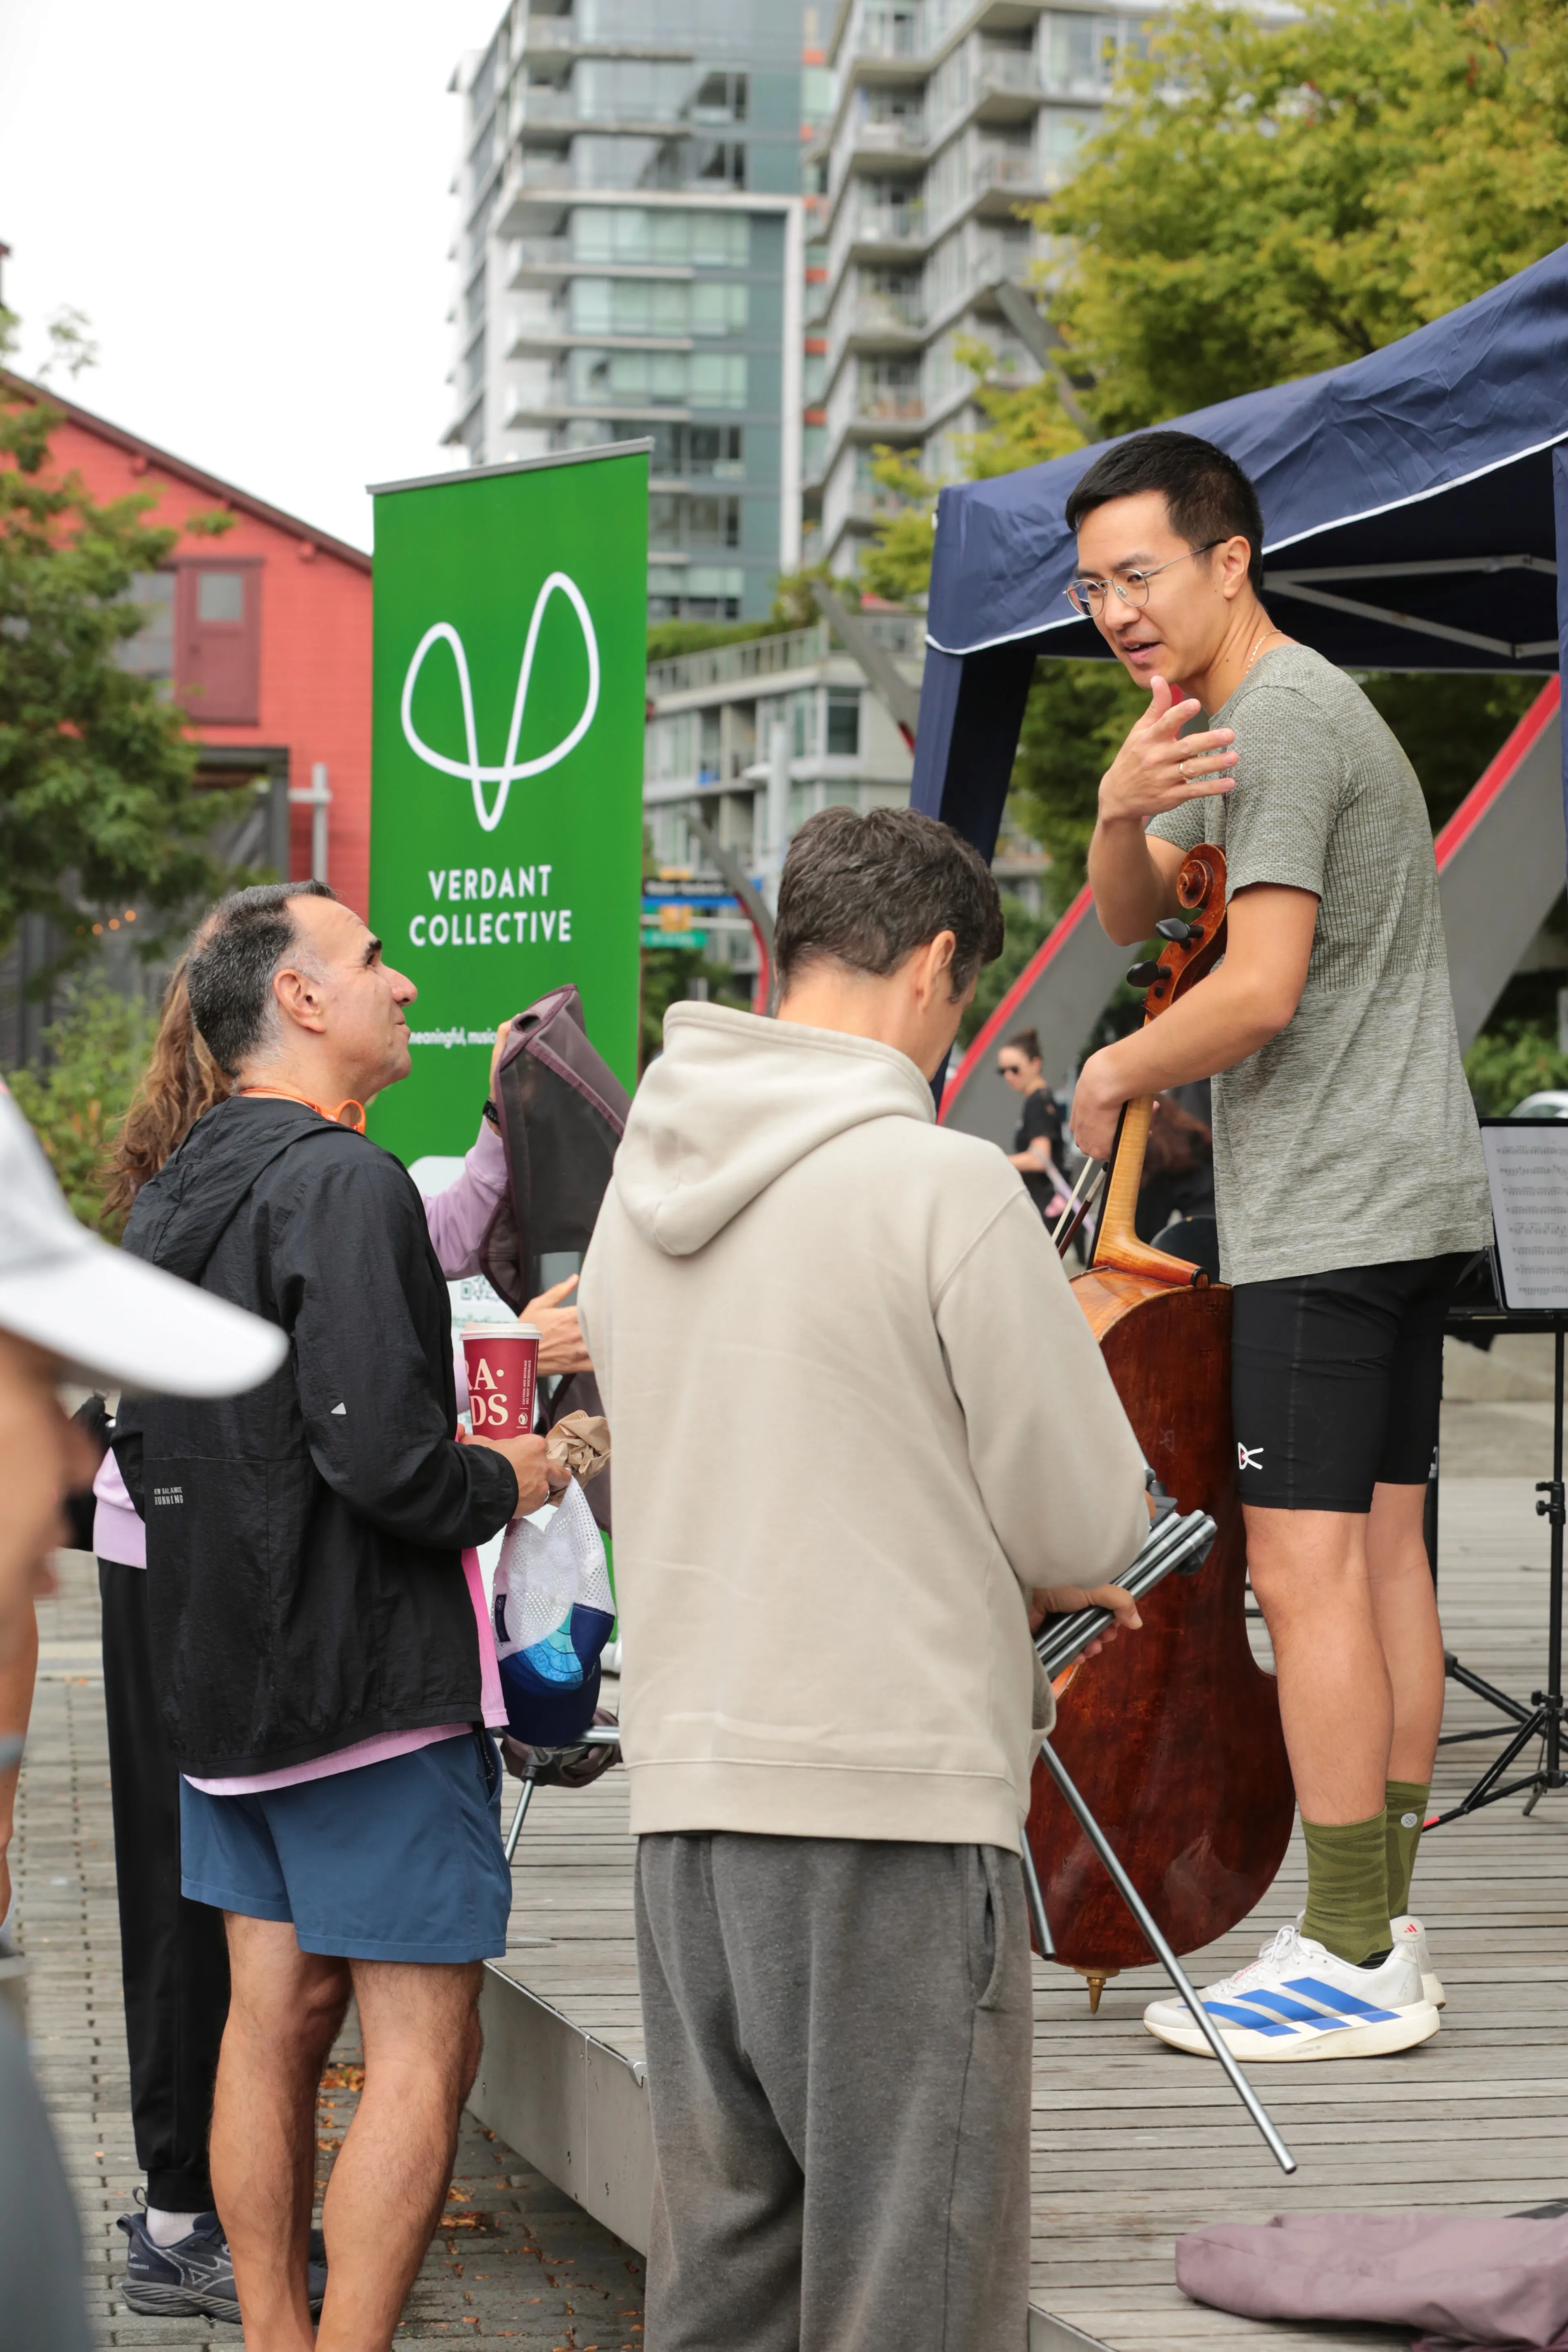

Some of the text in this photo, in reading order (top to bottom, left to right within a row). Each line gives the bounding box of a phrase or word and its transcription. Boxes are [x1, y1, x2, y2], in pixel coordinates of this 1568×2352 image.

[428, 864, 552, 901] VERDANT
[409, 910, 572, 947] COLLECTIVE
[154, 1494, 183, 1505] RUNNING
